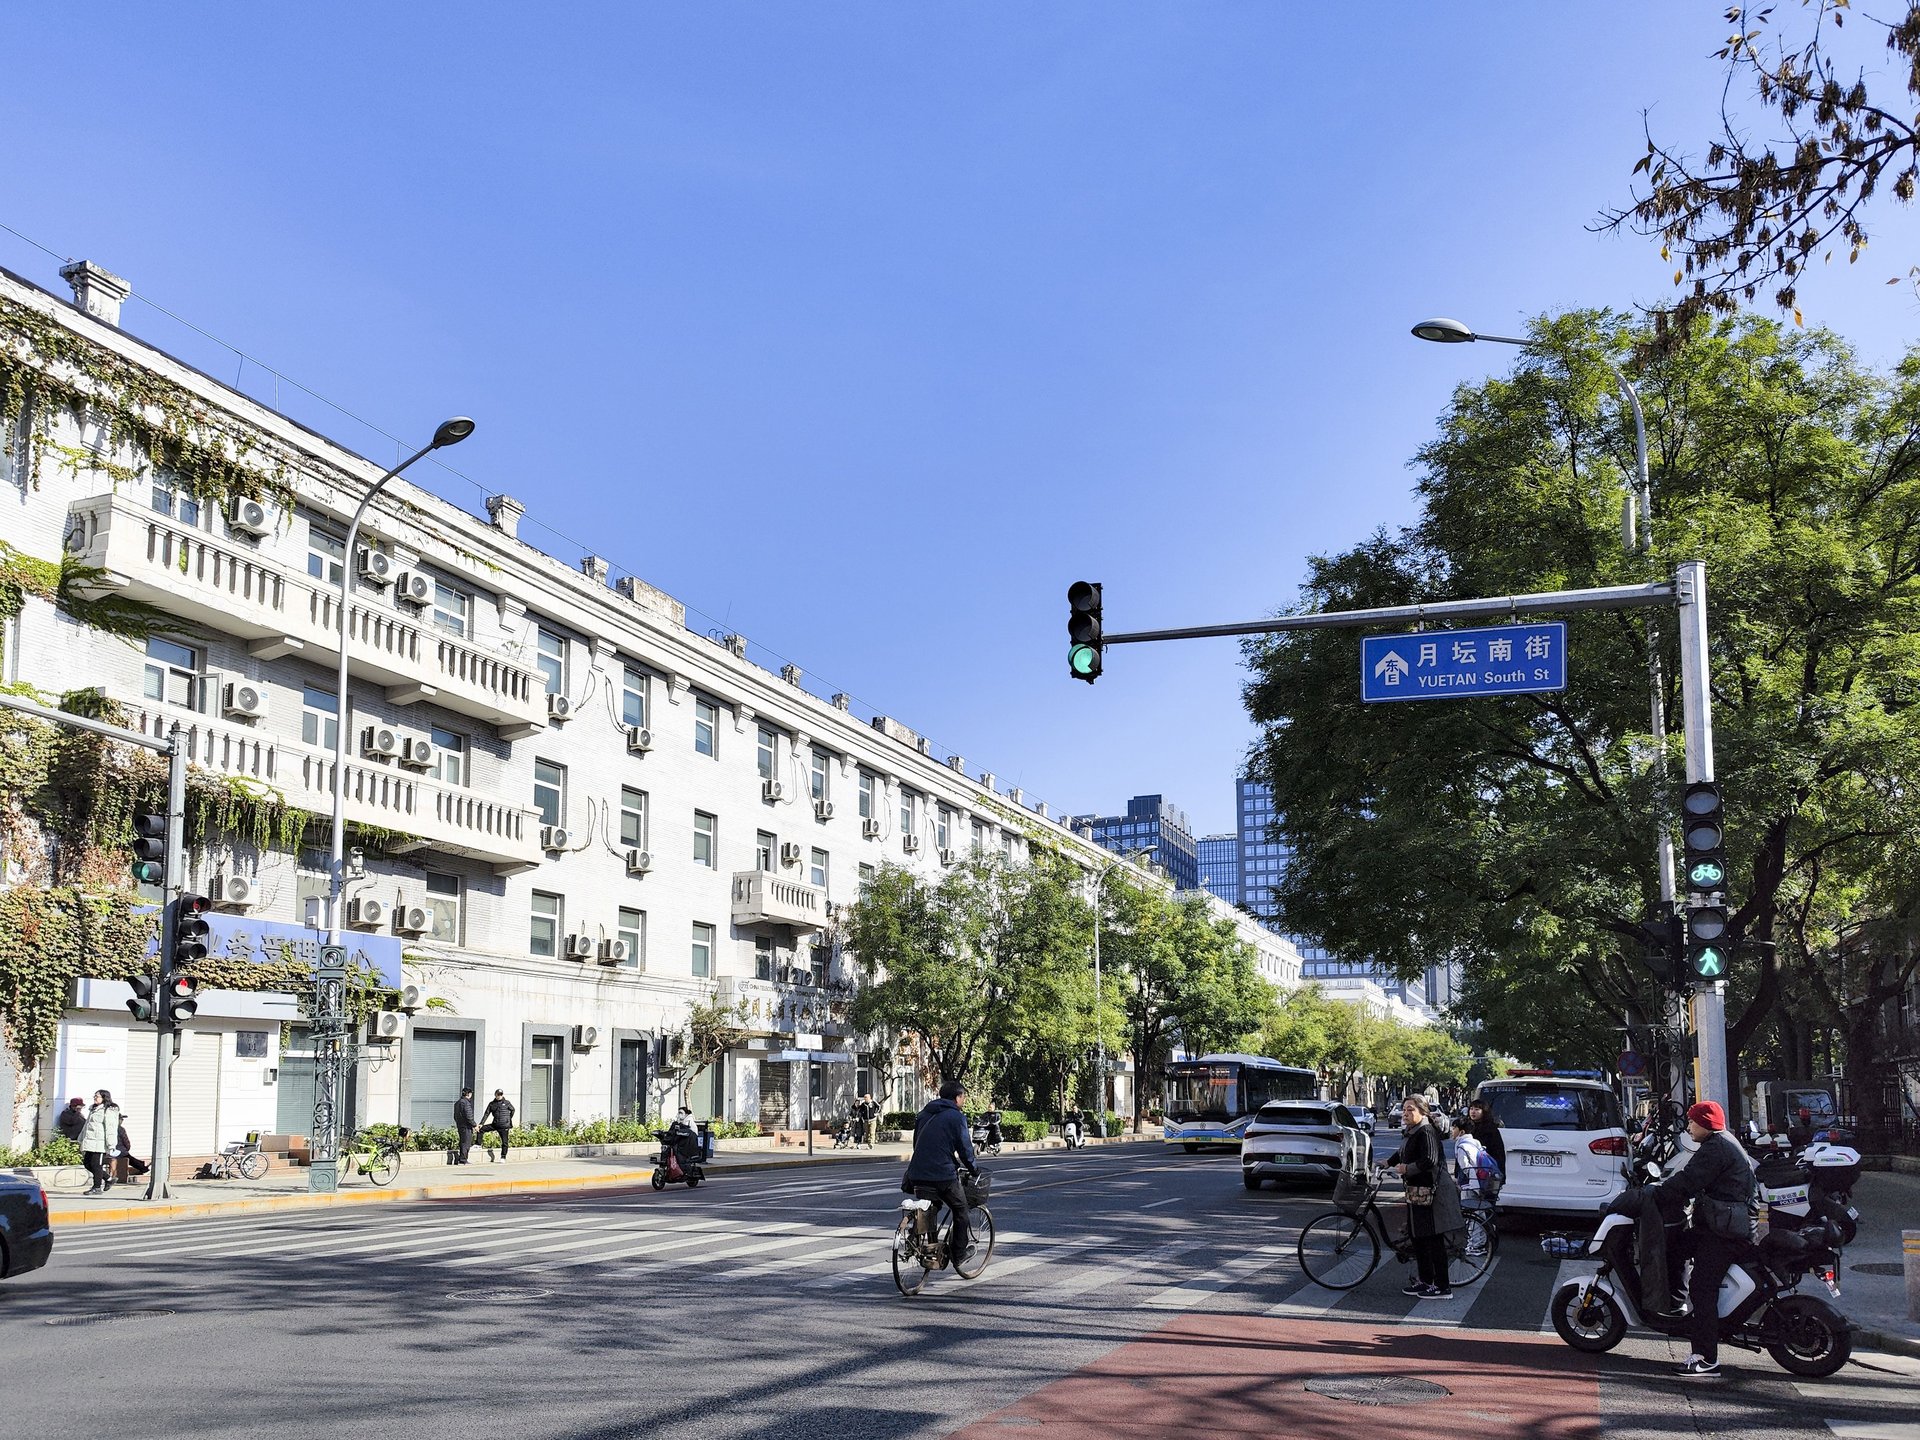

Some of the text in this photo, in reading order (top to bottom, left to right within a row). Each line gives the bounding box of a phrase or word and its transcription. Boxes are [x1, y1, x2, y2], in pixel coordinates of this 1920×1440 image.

[1416, 635, 1551, 668] 月坛南街
[1385, 659, 1399, 673] 东
[1388, 673, 1397, 683] E
[1418, 668, 1550, 688] YUETAN South St
